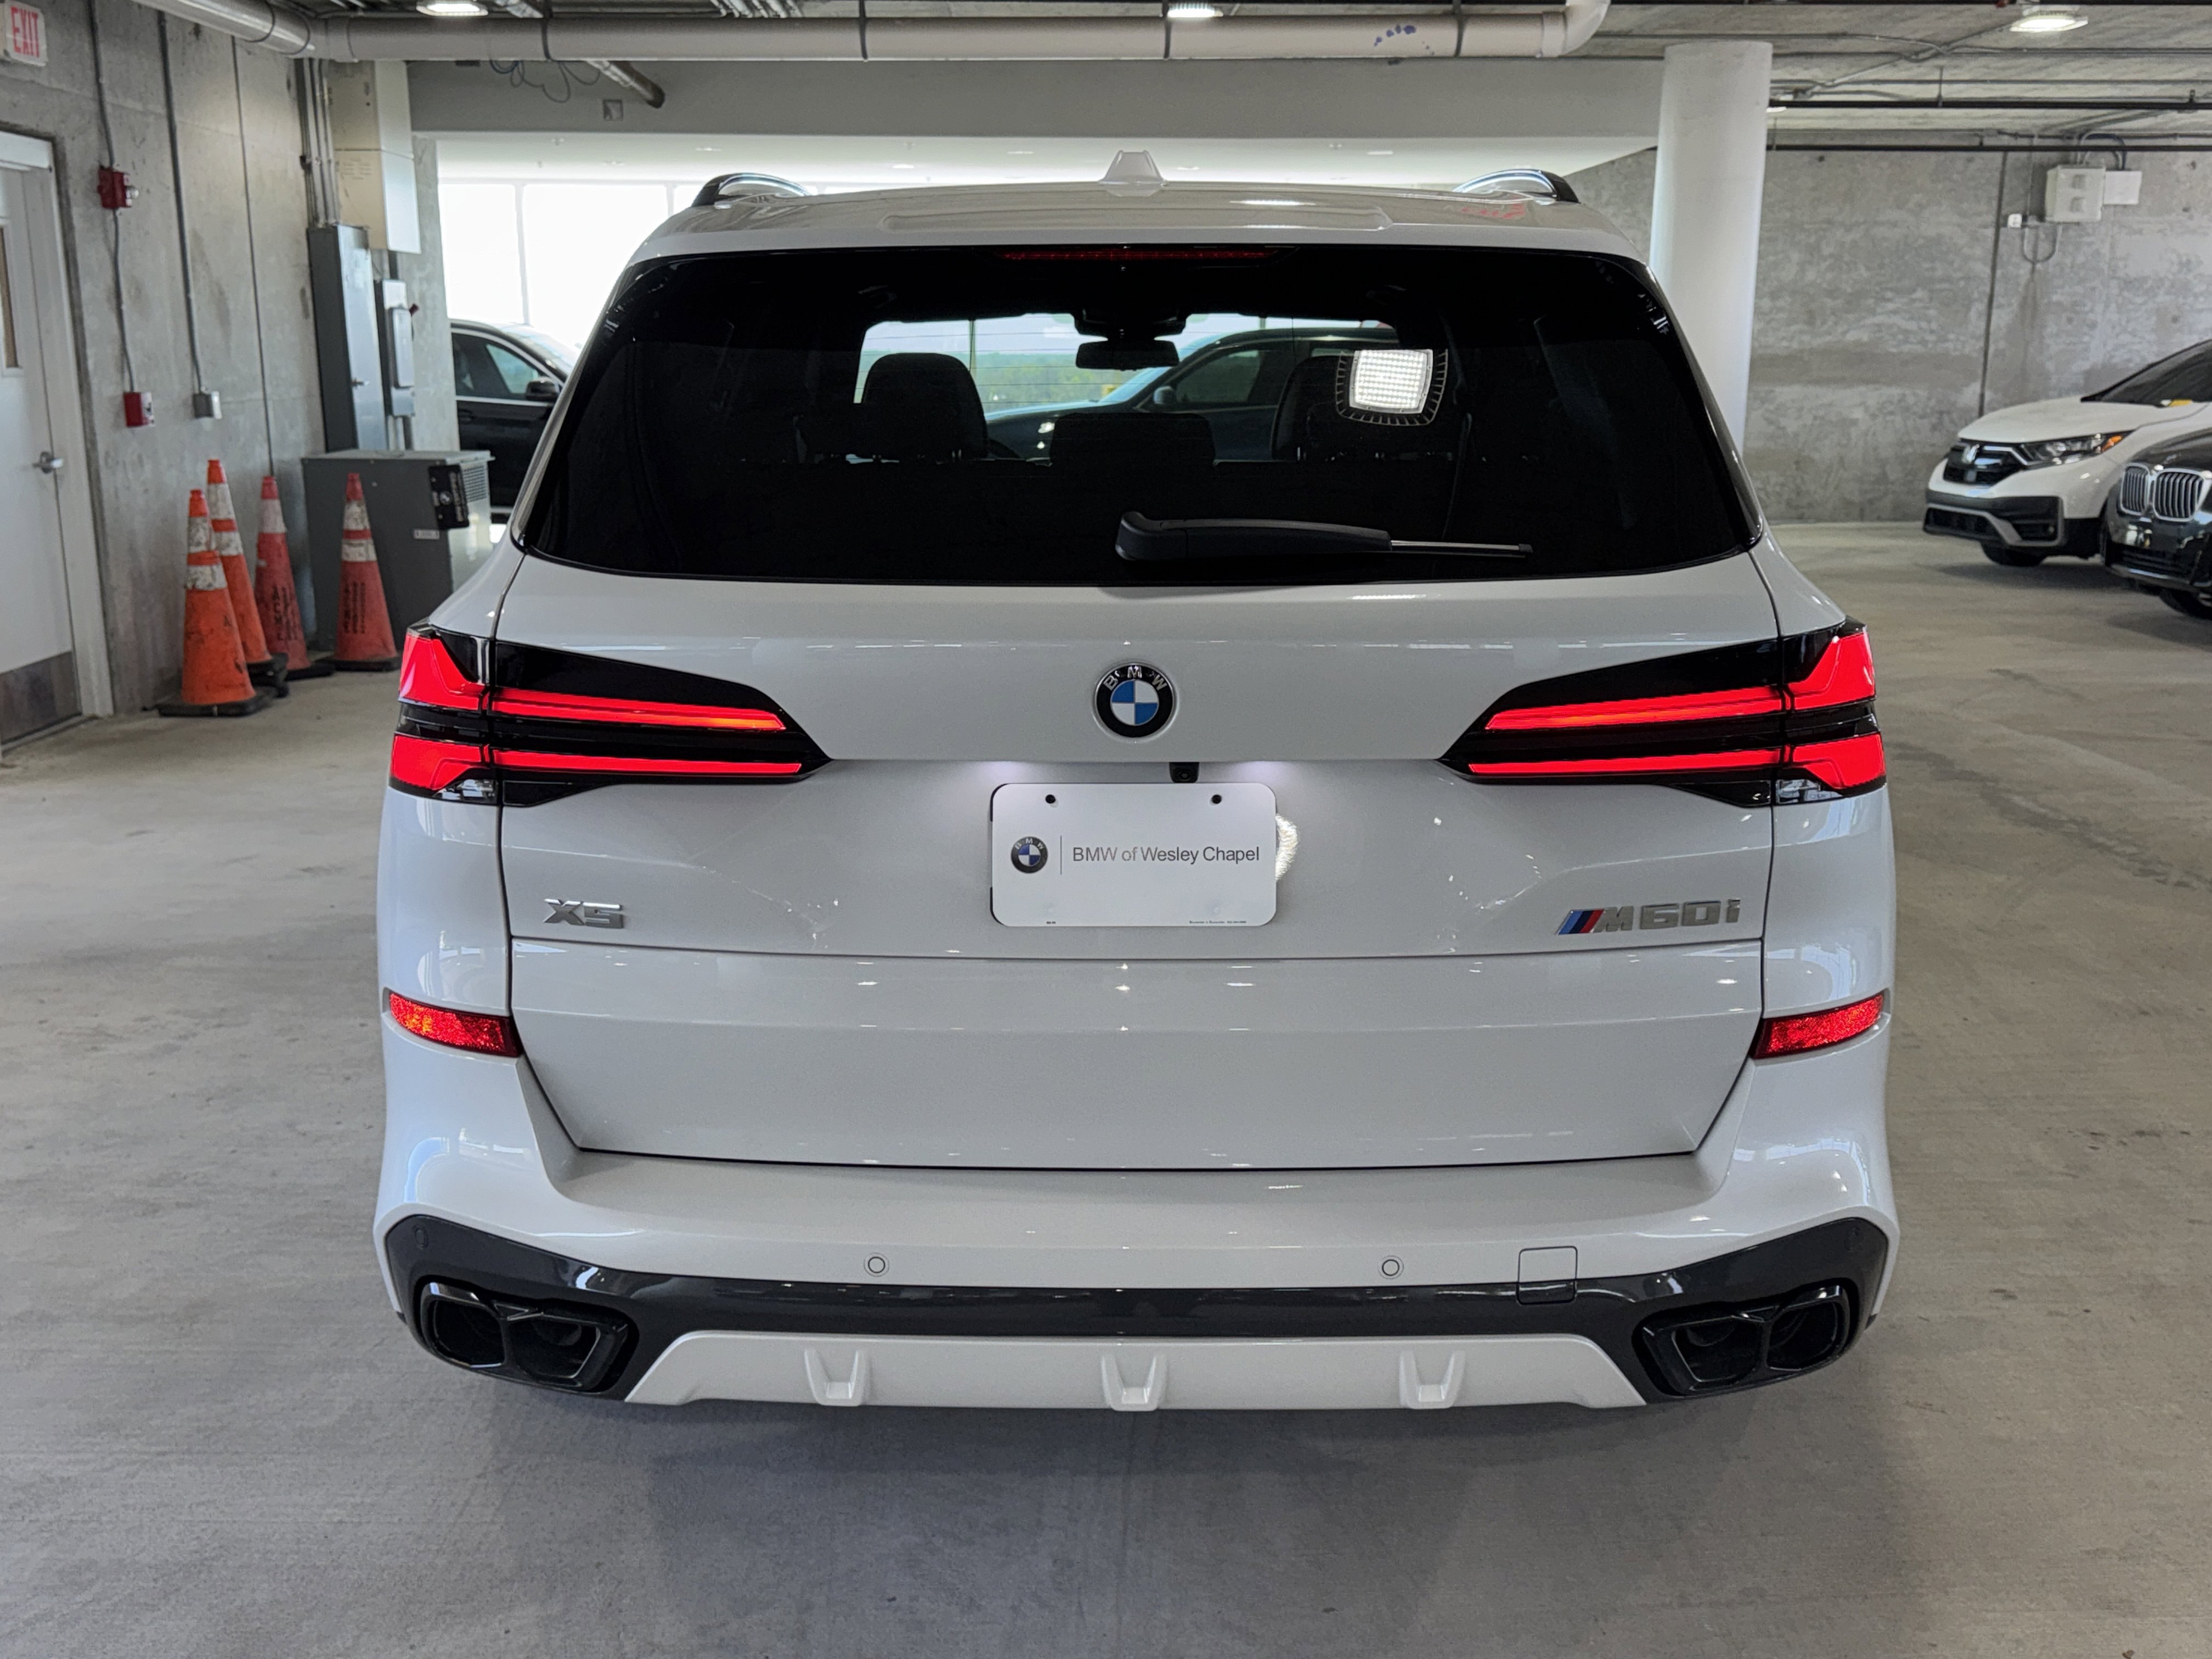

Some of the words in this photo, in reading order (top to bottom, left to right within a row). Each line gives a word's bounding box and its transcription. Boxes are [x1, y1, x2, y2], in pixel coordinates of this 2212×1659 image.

[10, 5, 40, 58] EXIT
[1103, 665, 1167, 691] BMW
[1014, 837, 1044, 850] BMW
[1073, 847, 1118, 861] BMW
[1121, 847, 1138, 861] of
[1140, 847, 1199, 865] Wesley
[1203, 847, 1259, 865] Chapel
[543, 898, 624, 929] X5
[1590, 898, 1741, 933] M60i
